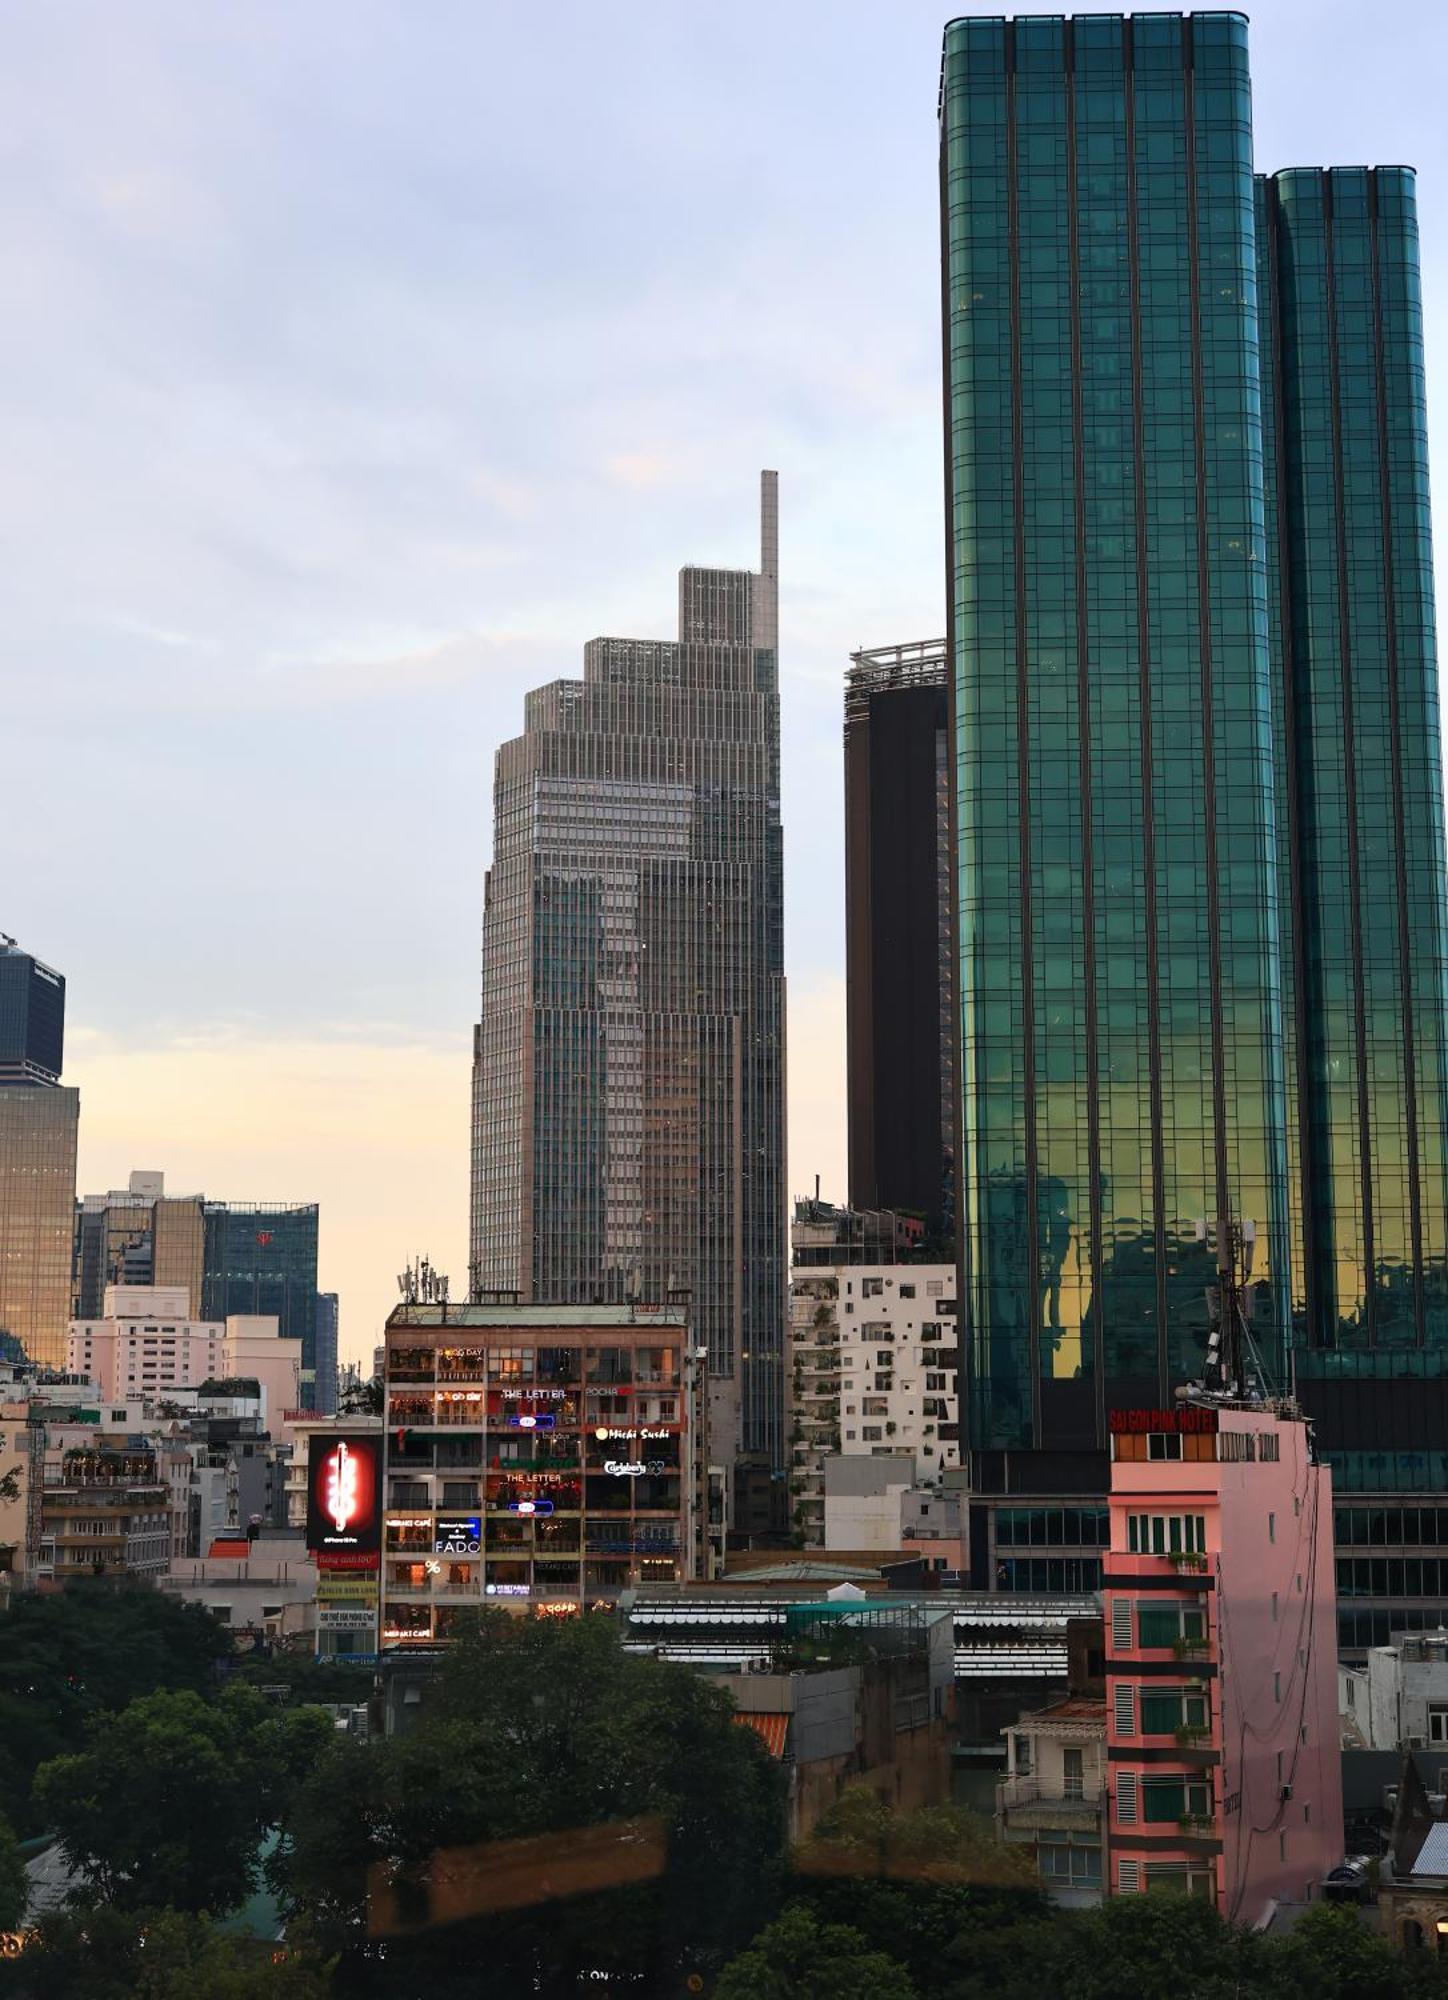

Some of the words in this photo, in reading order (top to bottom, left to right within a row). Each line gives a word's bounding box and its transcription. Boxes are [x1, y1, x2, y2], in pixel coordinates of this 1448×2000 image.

[502, 1389, 522, 1399] THE
[526, 1389, 566, 1400] LETTER
[1181, 1408, 1214, 1432] HOTEL
[609, 1429, 637, 1440] Michi
[640, 1428, 670, 1440] Sushi
[604, 1461, 647, 1476] Carlsberg
[506, 1474, 524, 1482] THE
[527, 1474, 561, 1482] LETTER
[435, 1541, 481, 1553] FADO
